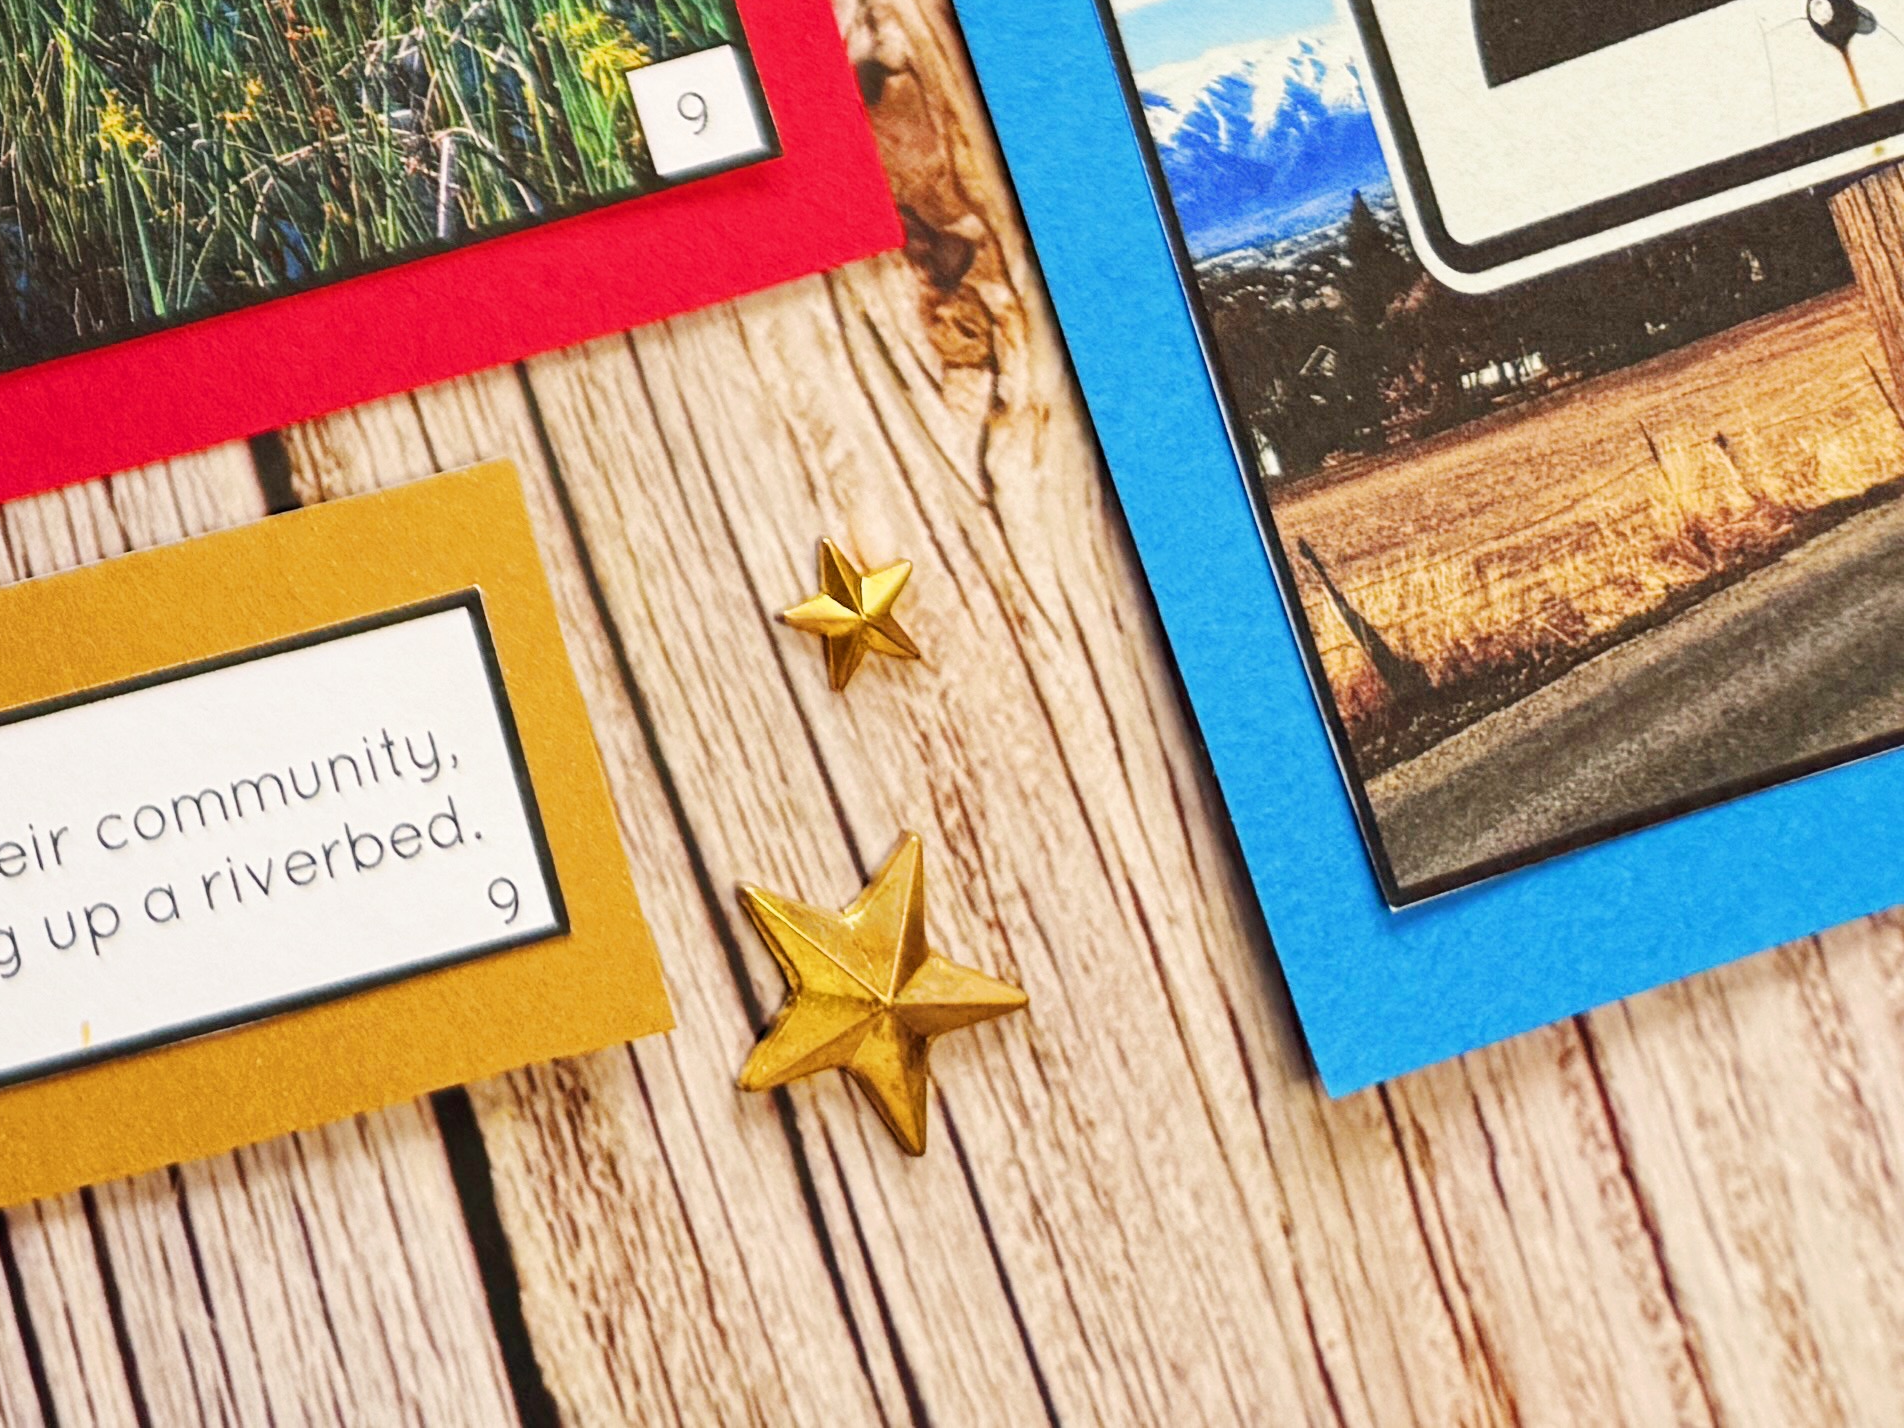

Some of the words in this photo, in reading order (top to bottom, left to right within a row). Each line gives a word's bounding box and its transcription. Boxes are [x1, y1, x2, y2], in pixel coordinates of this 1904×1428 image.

[677, 91, 708, 135] 9
[96, 724, 462, 853] community,
[46, 902, 122, 958] up
[144, 883, 183, 926] a
[202, 797, 485, 911] riverbed.
[488, 876, 520, 924] 9
